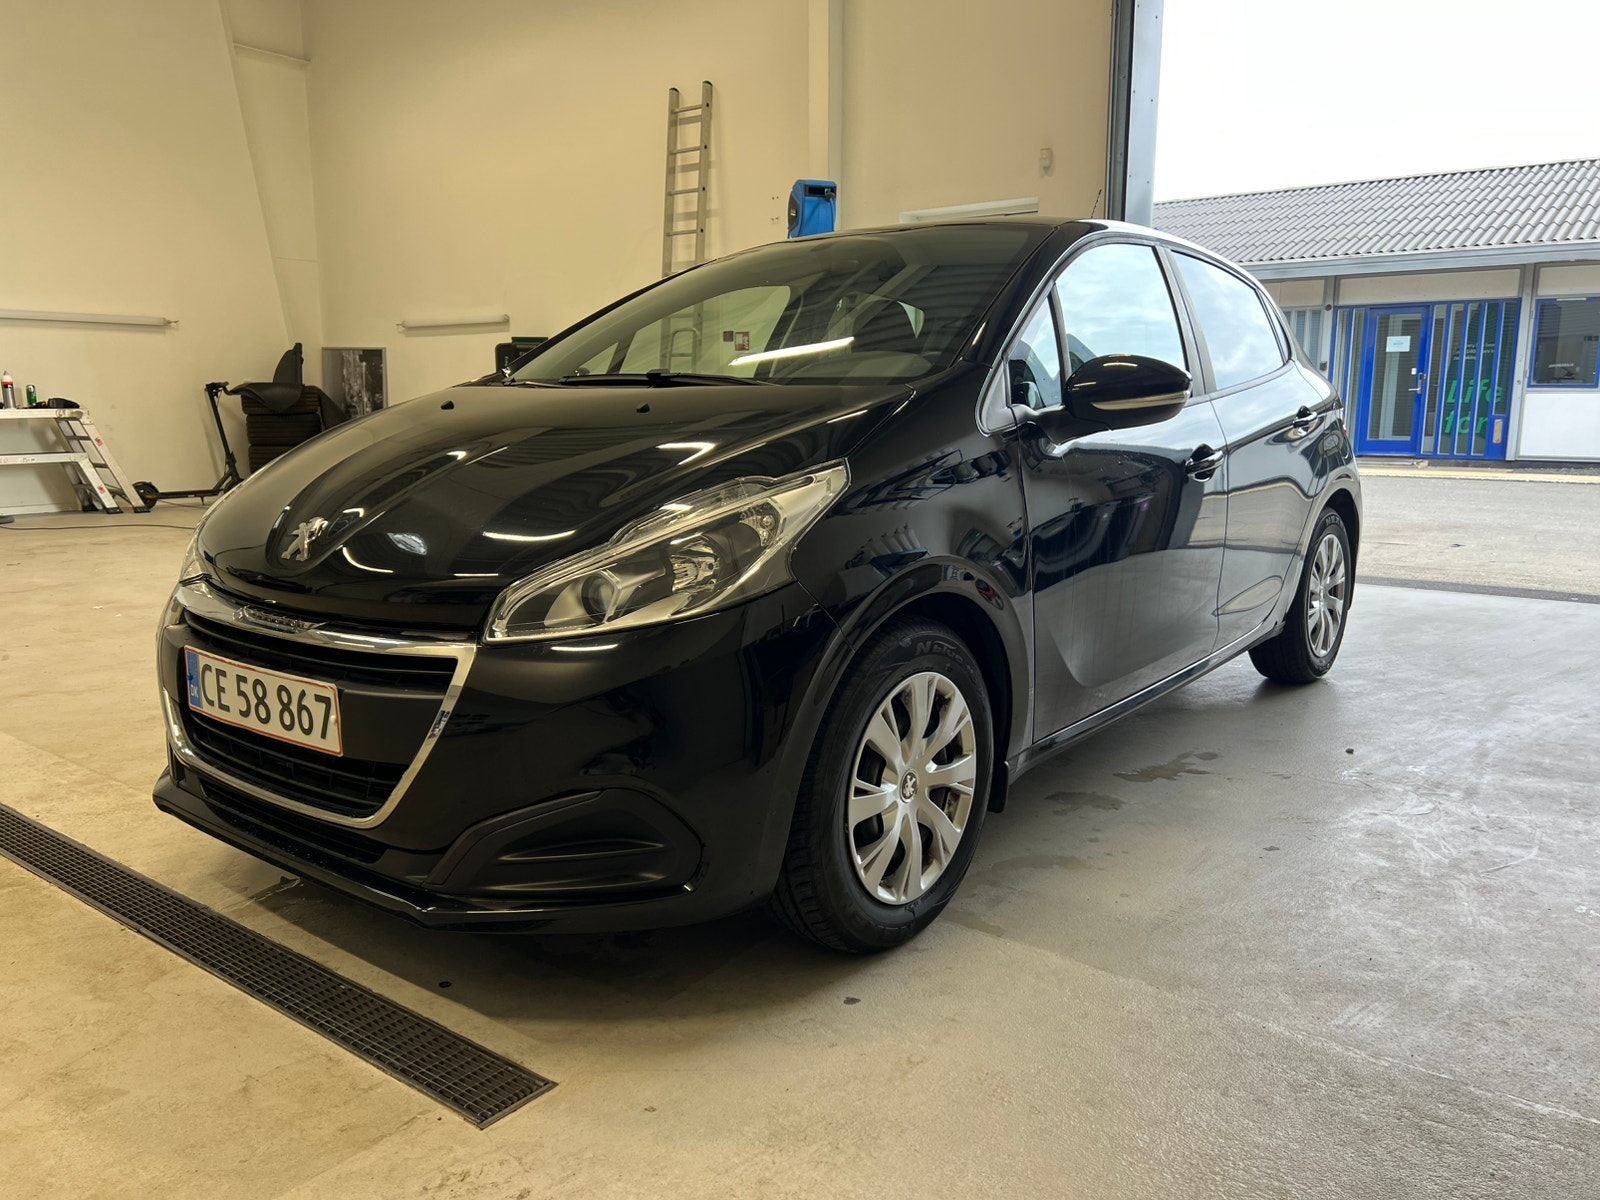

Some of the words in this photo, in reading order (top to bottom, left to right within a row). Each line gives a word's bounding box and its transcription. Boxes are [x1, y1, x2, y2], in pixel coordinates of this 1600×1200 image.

[201, 664, 230, 712] CE
[236, 675, 271, 724] 58
[277, 685, 331, 739] 867
